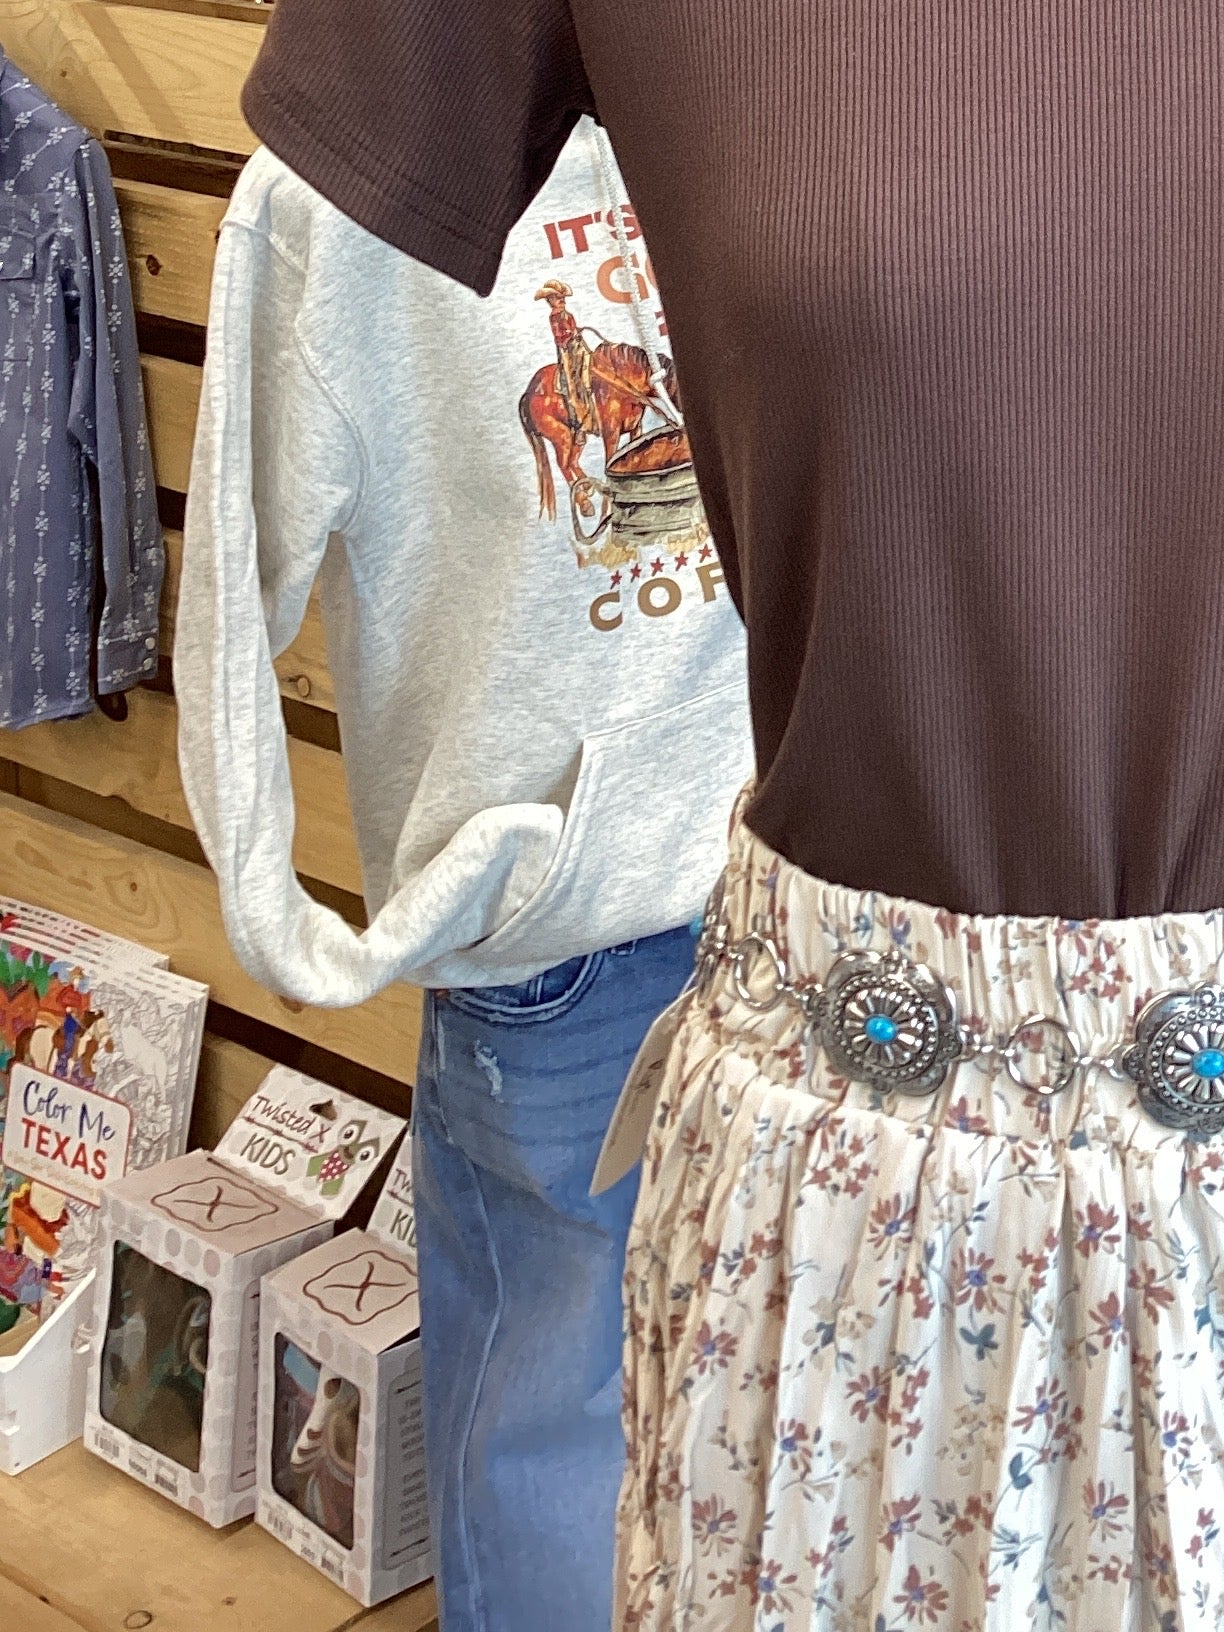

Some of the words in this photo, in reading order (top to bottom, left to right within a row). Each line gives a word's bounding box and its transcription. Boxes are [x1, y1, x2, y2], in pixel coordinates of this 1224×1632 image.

[543, 204, 642, 260] IT'S
[23, 1080, 72, 1124] Color
[79, 1102, 116, 1143] Me
[251, 1095, 317, 1136] Twisted
[309, 1123, 331, 1144] X
[21, 1117, 107, 1180] TEXAS
[240, 1132, 296, 1176] KIDS
